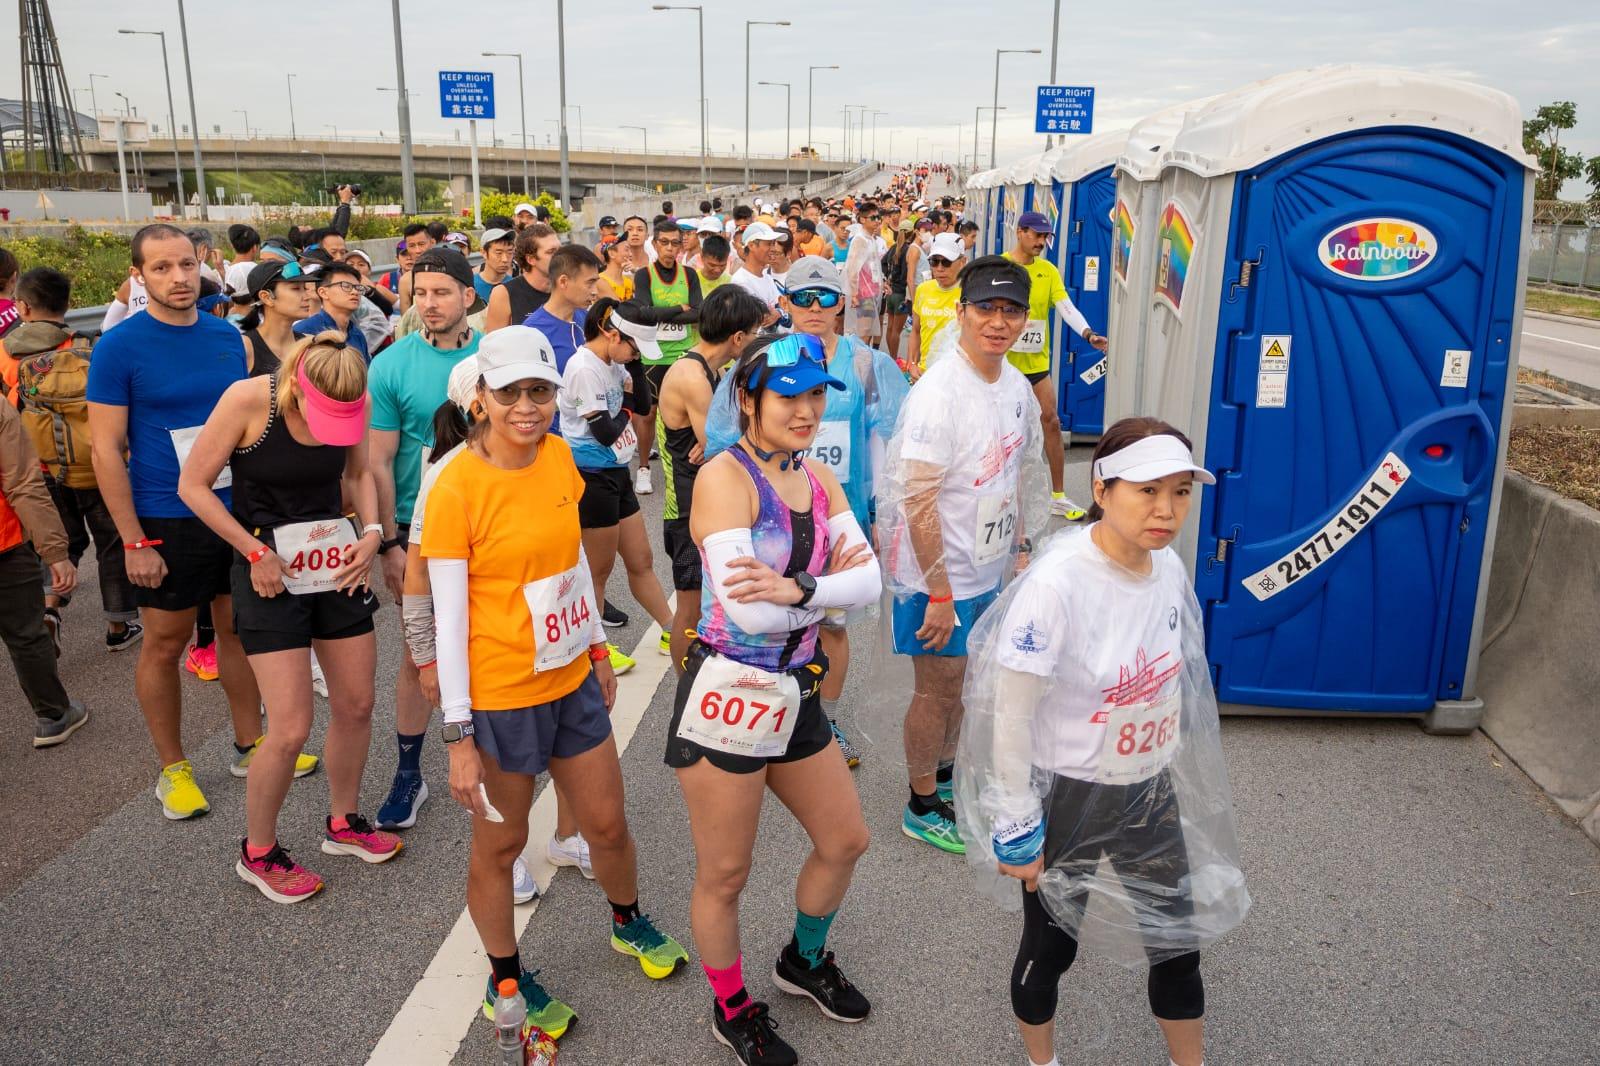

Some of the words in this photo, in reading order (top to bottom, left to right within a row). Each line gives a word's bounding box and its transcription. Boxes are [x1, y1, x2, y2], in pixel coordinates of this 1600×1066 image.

[441, 73, 463, 81] KEEP
[465, 74, 491, 82] RIGHT
[1040, 88, 1062, 96] KEEP
[1065, 89, 1092, 97] RIGHT
[1334, 243, 1425, 261] Rainbow
[132, 295, 149, 307] TC
[1277, 481, 1391, 583] 2477-1911
[545, 595, 590, 643] 8144
[700, 691, 787, 733] 6071
